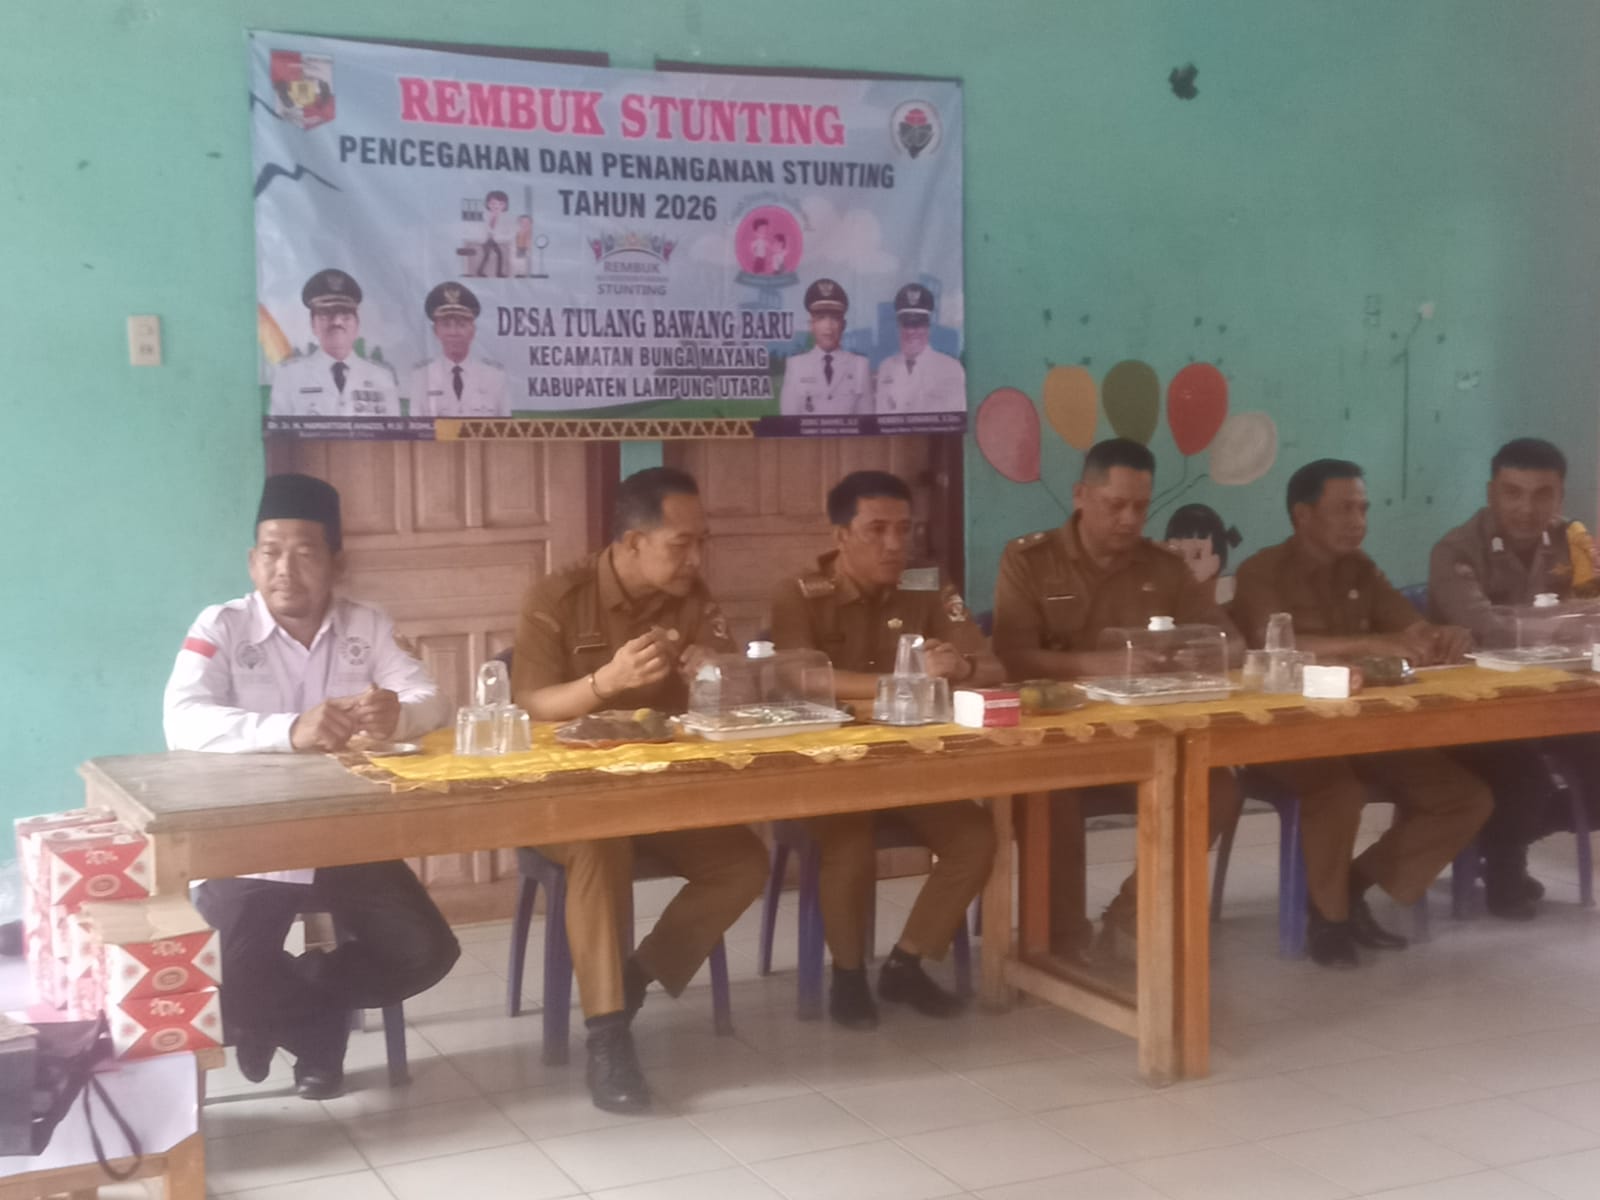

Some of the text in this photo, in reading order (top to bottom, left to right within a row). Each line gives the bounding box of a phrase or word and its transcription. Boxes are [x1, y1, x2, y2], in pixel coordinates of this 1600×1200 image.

[399, 78, 846, 146] REMBUK STUNTING
[339, 135, 895, 189] PENCEGAHAN DAN PENANGANAN STUNTING
[558, 189, 646, 219] TAHUN
[655, 194, 718, 221] 2026
[603, 261, 661, 273] REMBUK
[597, 283, 667, 296] STUNTING
[497, 306, 794, 339] DESA TULANG BAWANG BARU
[529, 345, 768, 368] KECAMATAN BUNGA MAYANG
[528, 376, 772, 398] KABUPATEN LAMPUNG UTARA
